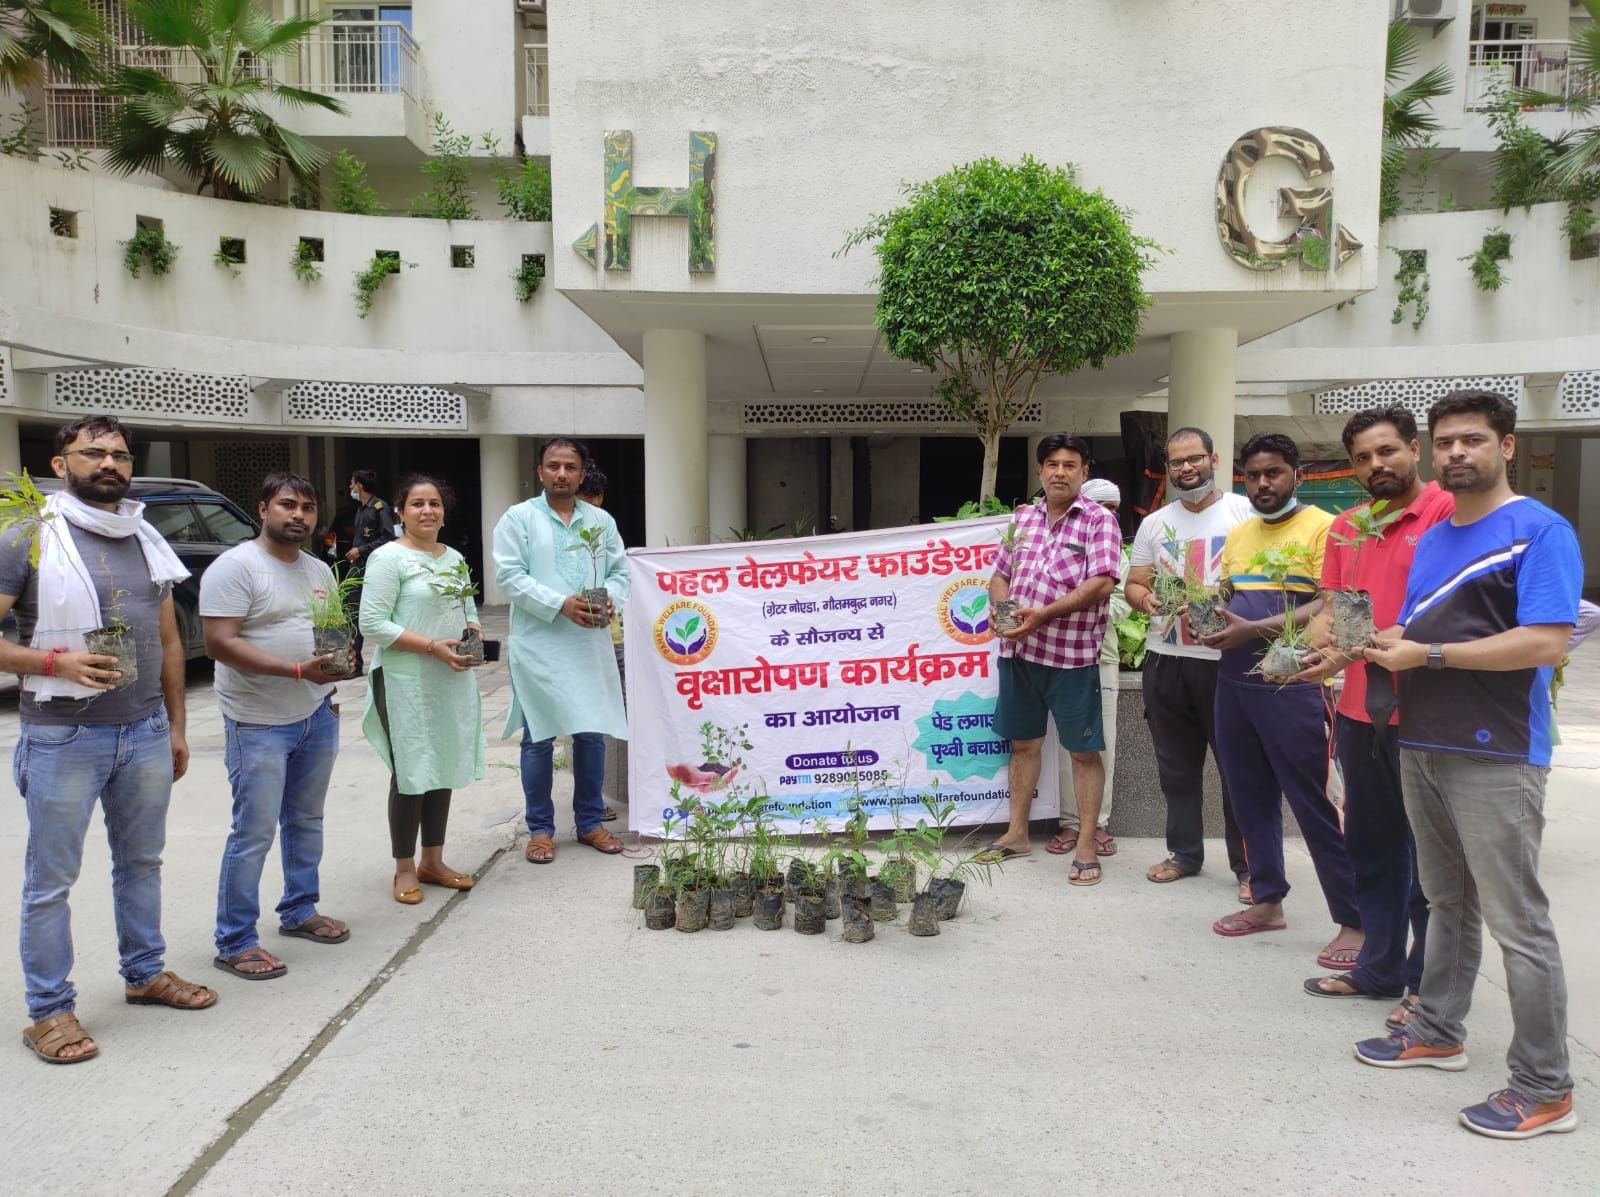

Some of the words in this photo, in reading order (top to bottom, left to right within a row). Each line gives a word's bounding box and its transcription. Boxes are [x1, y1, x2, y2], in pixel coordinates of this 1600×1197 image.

[604, 130, 716, 274] H
[1216, 126, 1336, 272] G
[656, 566, 732, 597] पहल
[736, 550, 861, 590] वेलफेयर
[869, 591, 897, 610] नगर)
[943, 578, 978, 603] WELFARE
[658, 601, 692, 625] WELFARE
[692, 602, 716, 652] FOUNDATION
[769, 629, 790, 647] के
[796, 625, 862, 646] सौजन्य
[867, 622, 886, 640] से
[674, 655, 830, 711] वृक्षारोपण
[839, 642, 991, 687] कार्यक्रम
[764, 711, 797, 729] का
[802, 702, 901, 727] आयोजन
[931, 711, 954, 731] पेड
[792, 755, 838, 768] Donate
[857, 754, 873, 764] us
[930, 737, 964, 765] पृथ्वी
